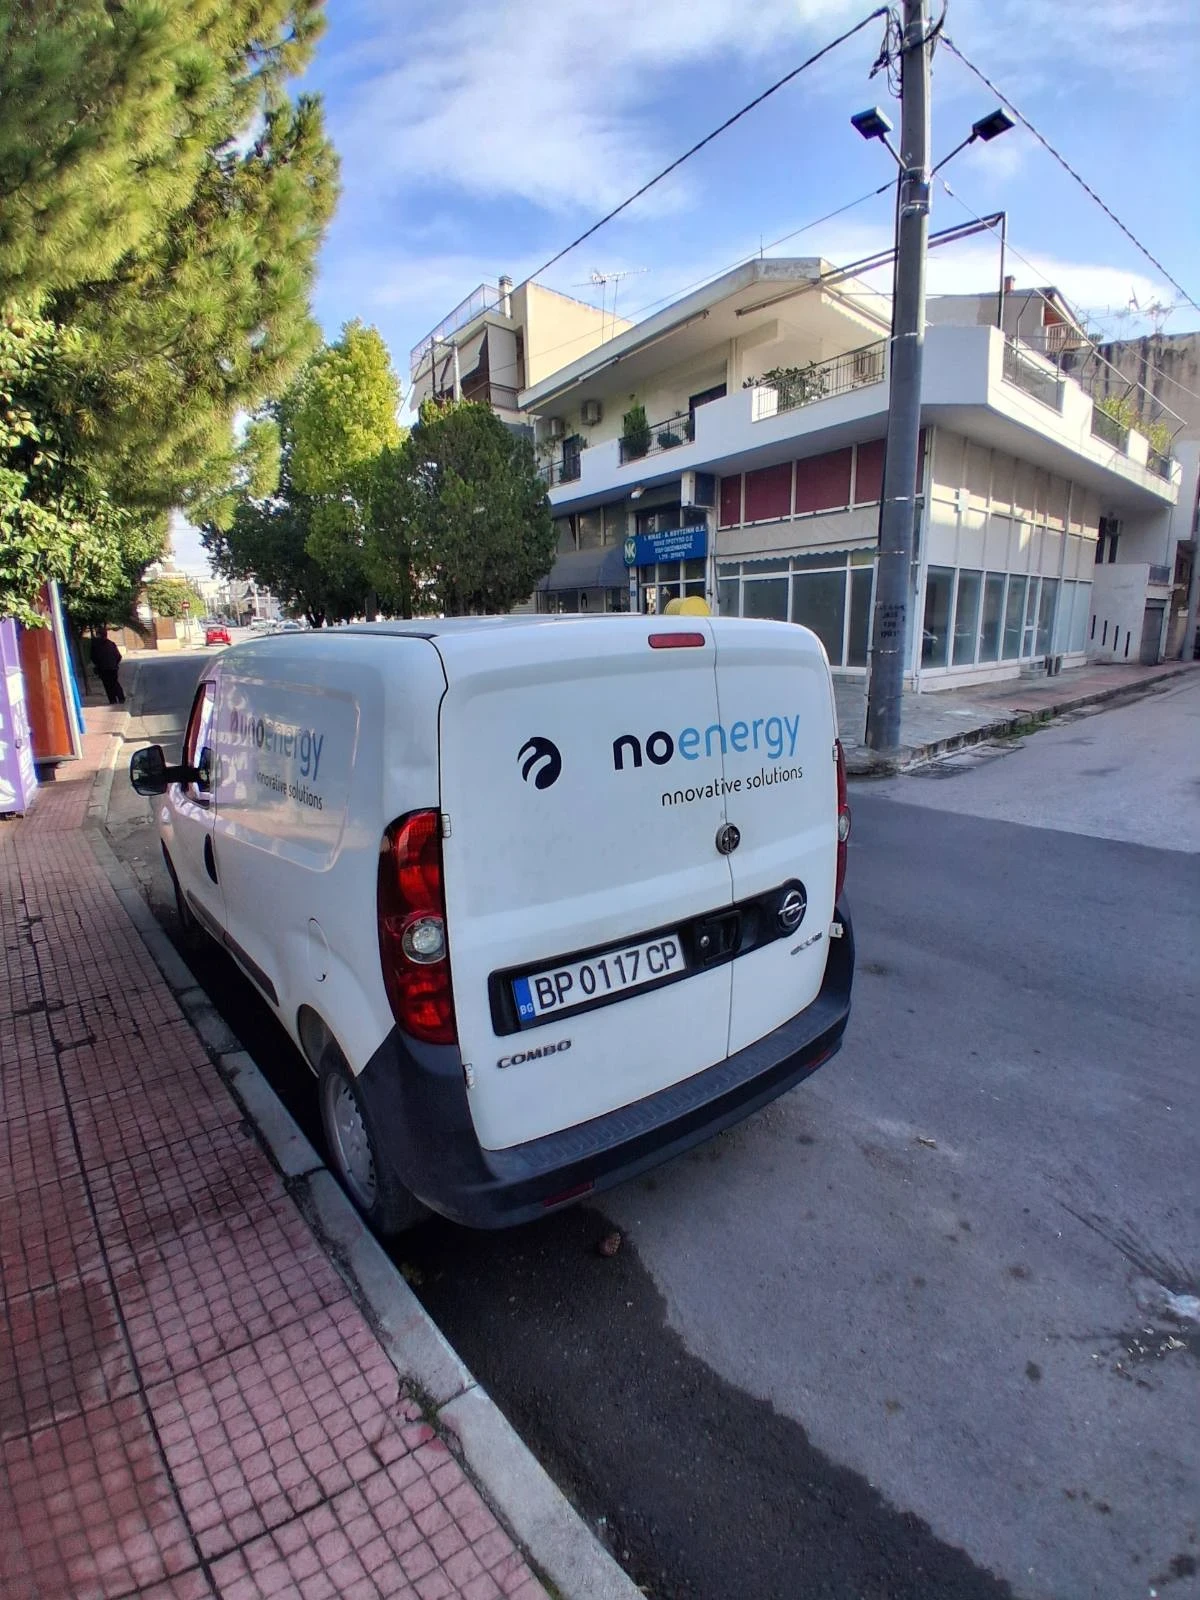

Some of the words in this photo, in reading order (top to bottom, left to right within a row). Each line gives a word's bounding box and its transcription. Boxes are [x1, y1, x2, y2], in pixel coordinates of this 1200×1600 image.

[612, 714, 800, 771] noenergy
[289, 780, 323, 811] solutions
[661, 778, 742, 807] nnovative
[746, 766, 803, 790] solutions
[534, 971, 573, 1010] BP
[579, 950, 640, 995] 0117
[645, 940, 677, 974] CP
[520, 1005, 534, 1016] BG
[496, 1039, 572, 1069] COMBO
